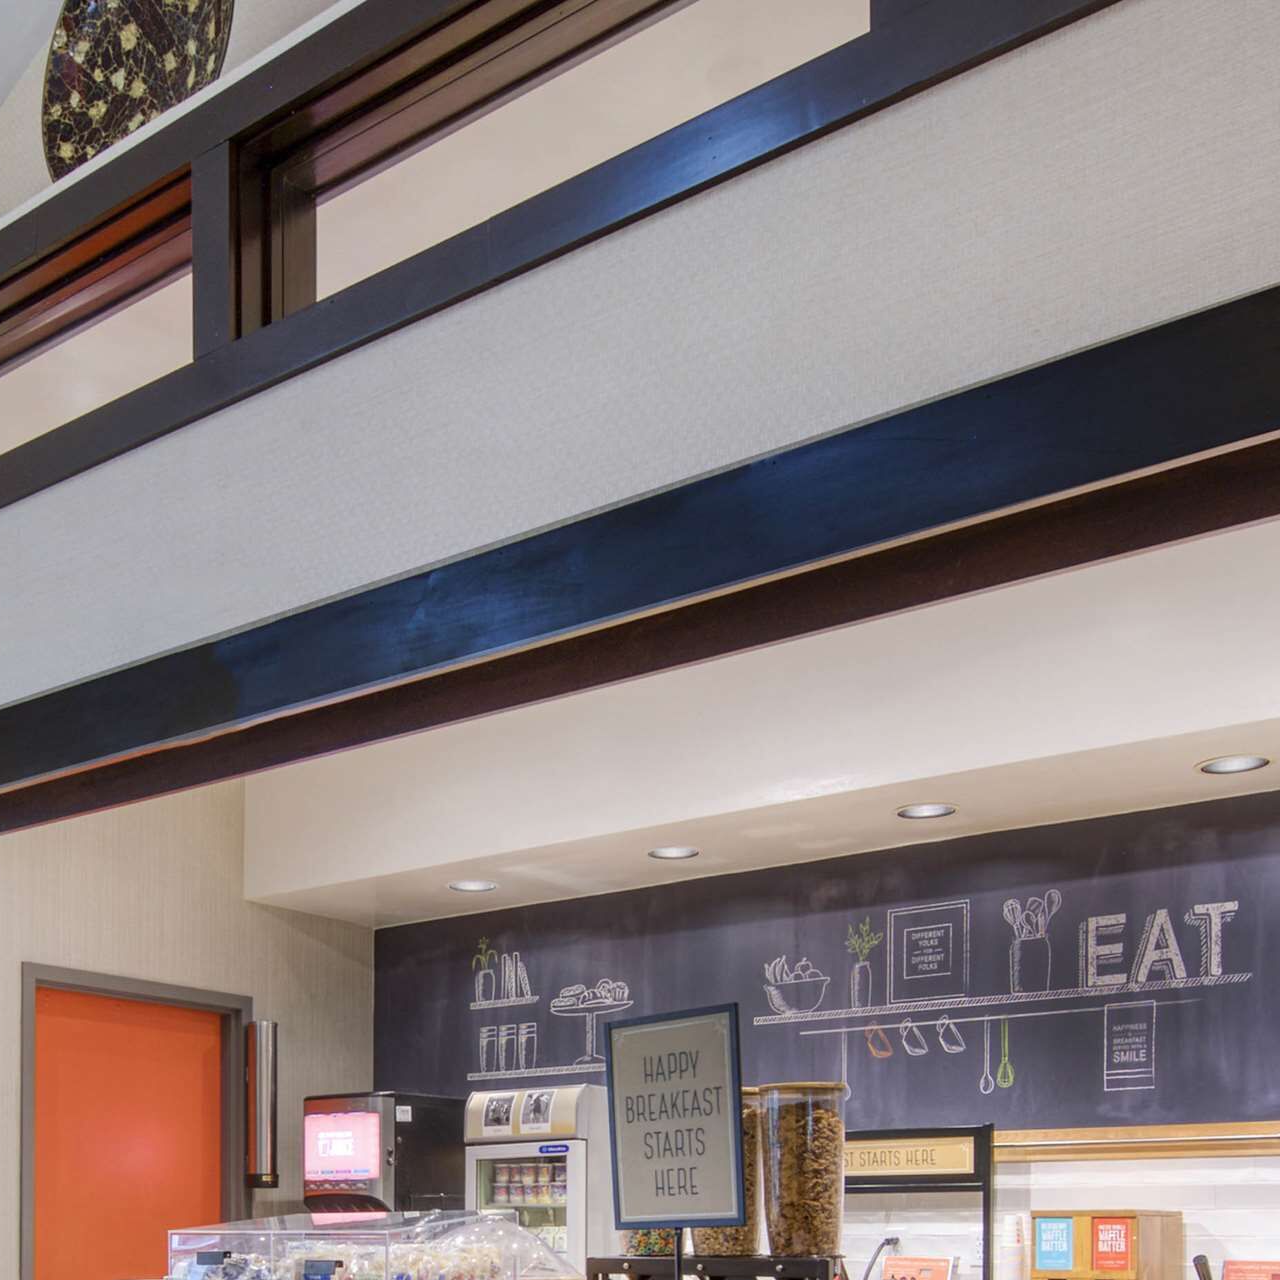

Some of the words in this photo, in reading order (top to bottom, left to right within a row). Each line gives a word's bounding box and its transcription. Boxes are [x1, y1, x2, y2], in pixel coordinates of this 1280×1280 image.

[912, 930, 945, 940] DIFFERENT
[918, 938, 939, 948] YOLKS
[1083, 900, 1240, 987] EAT
[912, 953, 945, 964] DIFFERENT
[918, 962, 938, 971] FOLKS
[1112, 1023, 1147, 1031] HAPPINESS
[1113, 1036, 1146, 1044] BREAKFAST
[1113, 1050, 1147, 1063] SMILE
[643, 1050, 700, 1084] HAPPY
[625, 1086, 723, 1124] BREAKFAST
[643, 1127, 706, 1160] STARTS
[858, 1149, 901, 1168] STARTS
[905, 1148, 937, 1167] HERE
[654, 1166, 699, 1197] HERE
[1041, 1230, 1068, 1241] WAFFLE
[1097, 1230, 1126, 1241] WAFFLE
[1041, 1240, 1068, 1252] BATTER
[1097, 1240, 1126, 1253] BATTER
